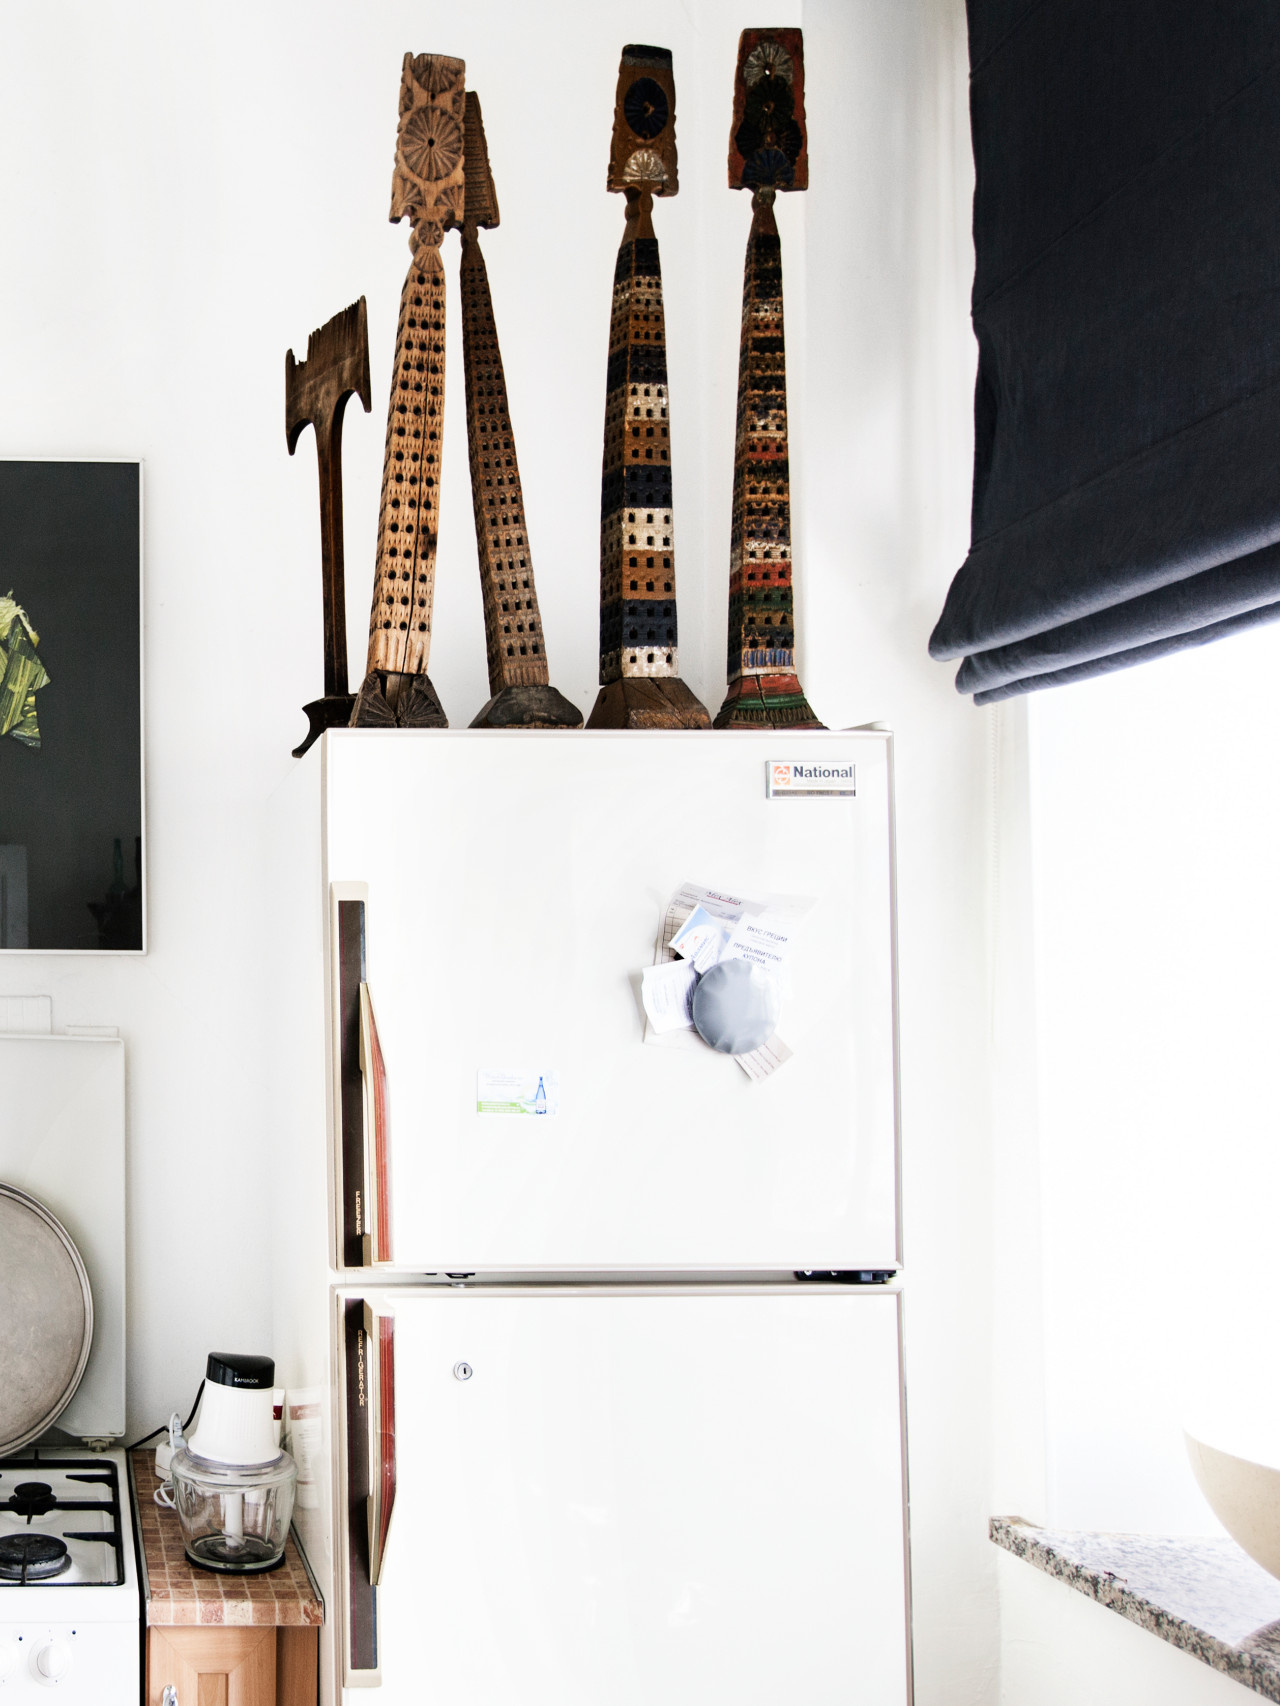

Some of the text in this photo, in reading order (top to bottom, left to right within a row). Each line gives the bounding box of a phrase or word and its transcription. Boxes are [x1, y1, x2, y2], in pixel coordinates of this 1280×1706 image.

[793, 766, 852, 778] National
[746, 925, 763, 936] ВКУС
[763, 930, 788, 943] ГРЕЦИИ
[733, 942, 782, 963] ПРЕДЪЯВИТЕЛЮ
[742, 953, 766, 965] КУПОНА
[357, 1329, 365, 1407] REFRIGERATOR
